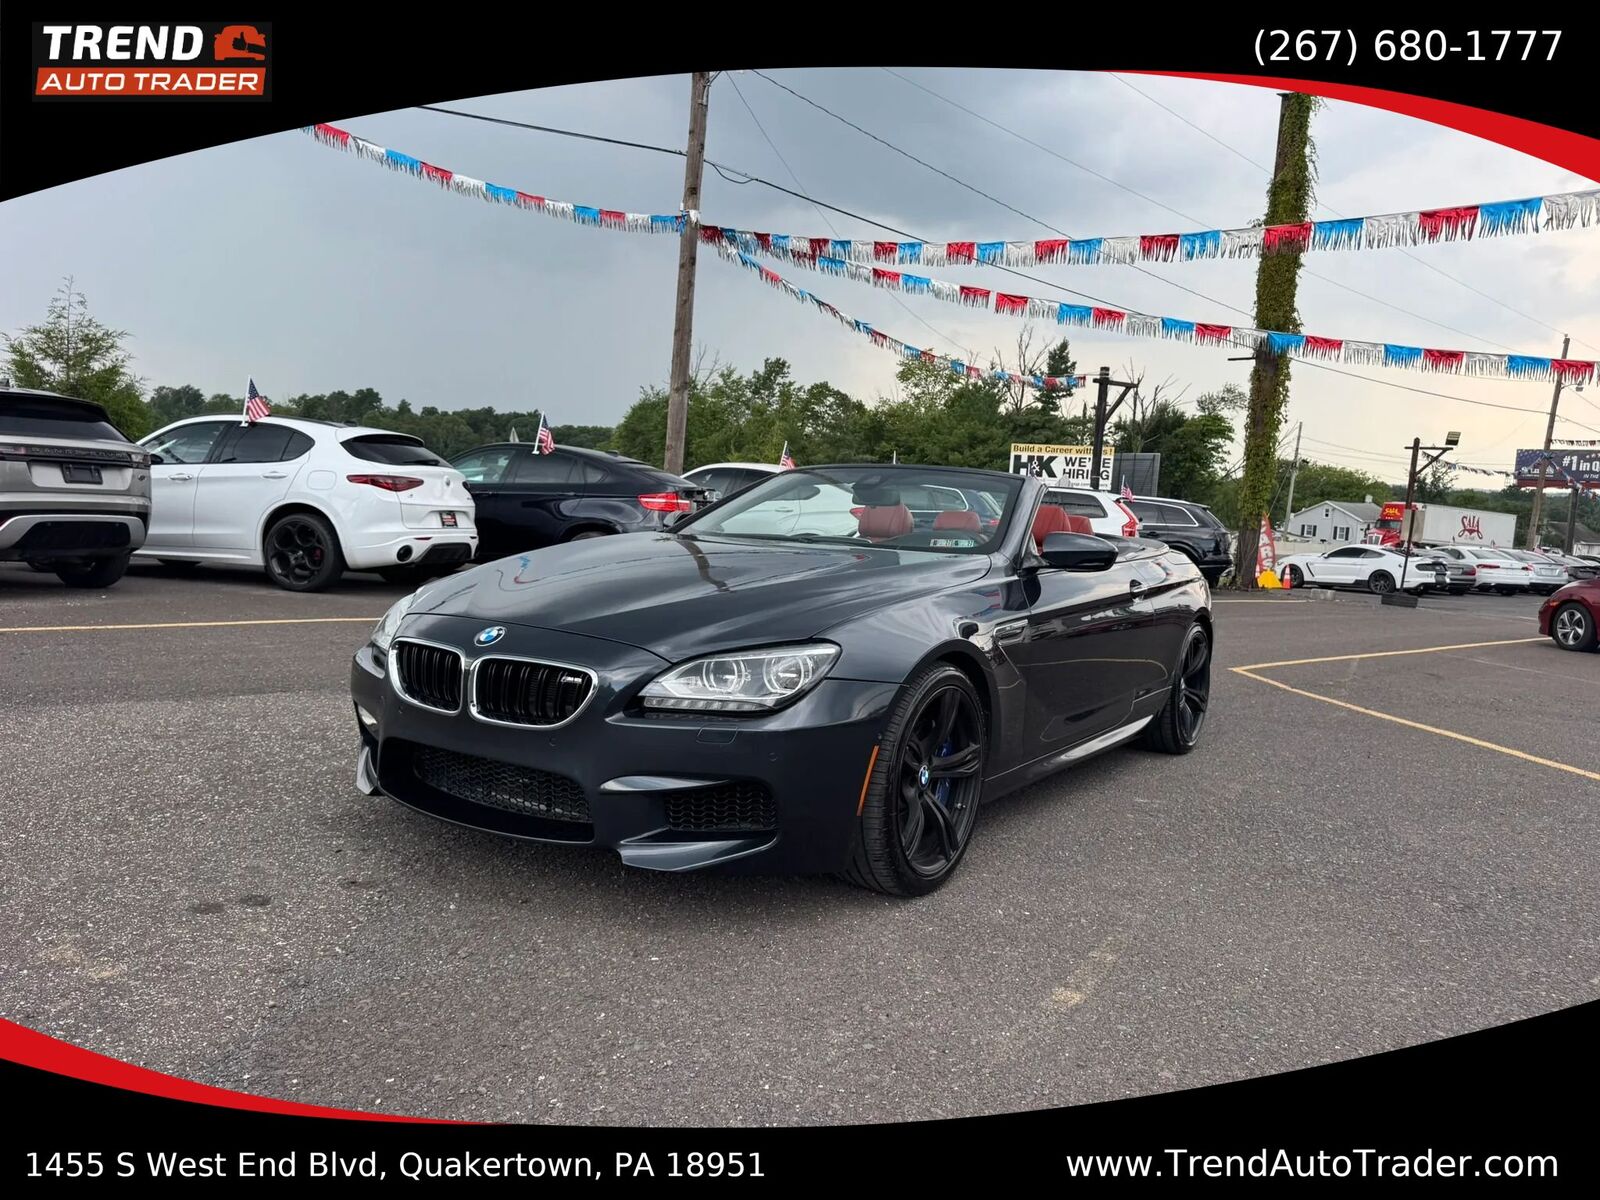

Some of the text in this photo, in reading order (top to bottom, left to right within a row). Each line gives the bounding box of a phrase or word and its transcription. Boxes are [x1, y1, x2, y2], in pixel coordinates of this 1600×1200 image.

[1013, 444, 1035, 453] Build
[1045, 445, 1073, 454] Career
[1064, 456, 1111, 469] WE'E
[1562, 455, 1578, 472] #1
[1579, 460, 1590, 472] in
[1062, 468, 1111, 480] HIRIG
